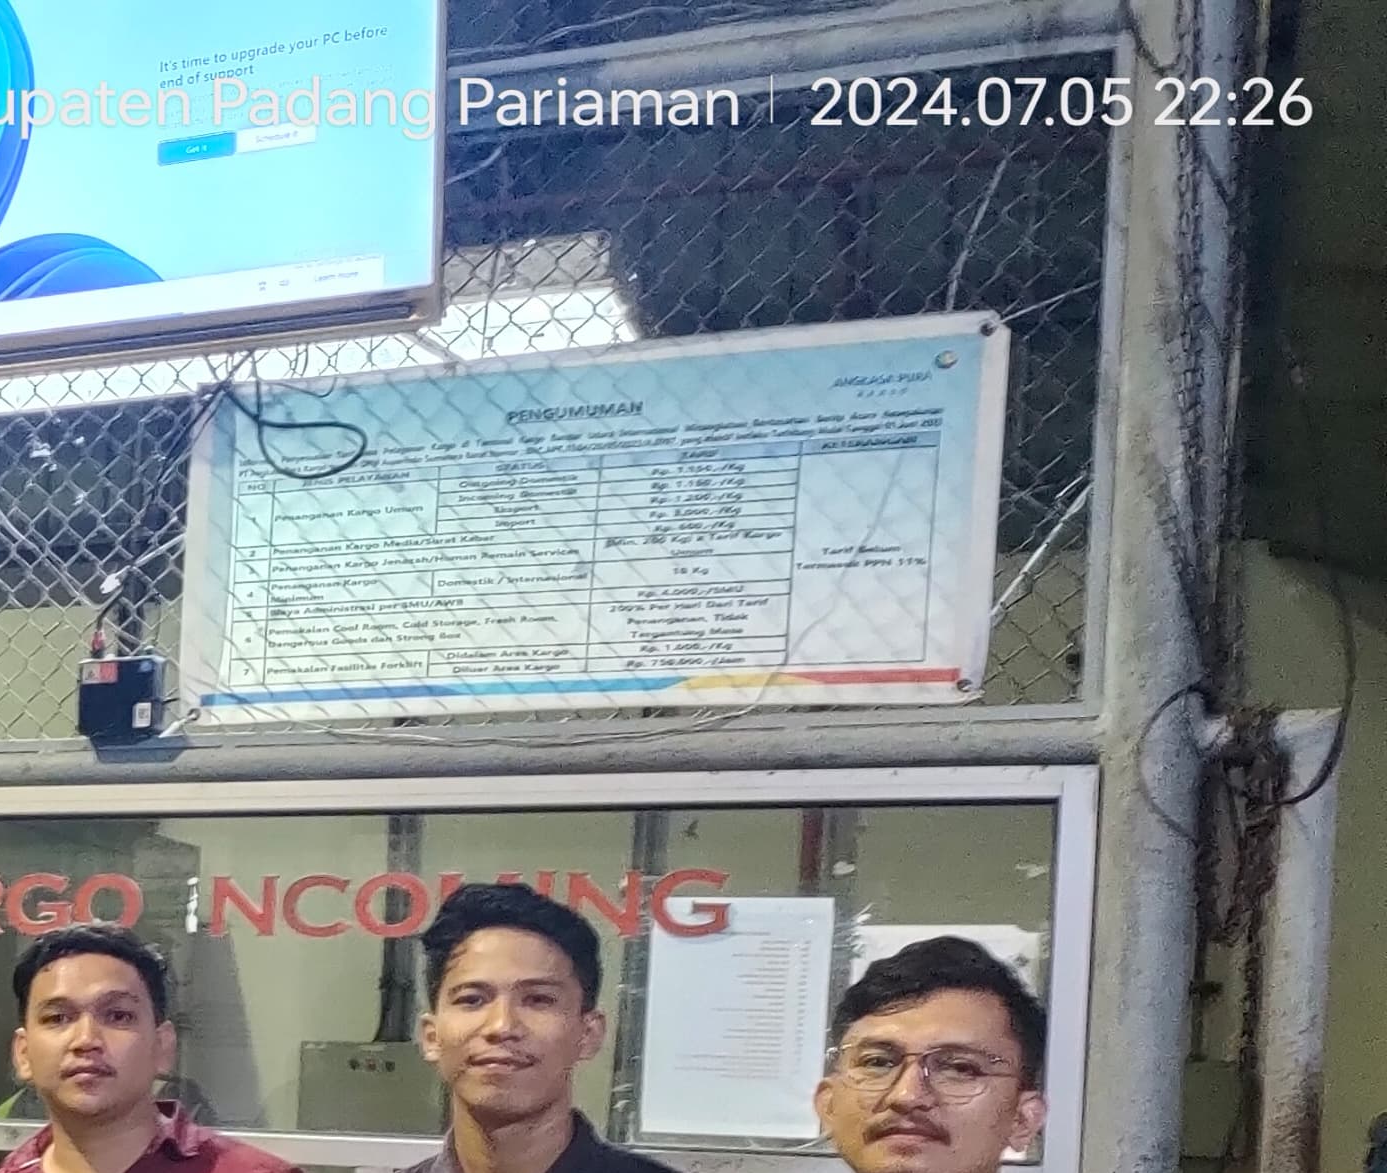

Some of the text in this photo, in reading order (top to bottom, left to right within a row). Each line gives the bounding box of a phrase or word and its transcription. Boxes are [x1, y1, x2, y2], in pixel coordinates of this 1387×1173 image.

[160, 26, 388, 73] It's time to upgrade your PC before
[160, 75, 183, 89] end
[187, 71, 200, 84] of
[507, 401, 643, 423] PENGUMUMAN
[347, 508, 381, 517] Kargo
[273, 545, 341, 556] Penanganan
[345, 541, 380, 551] Kargo
[345, 559, 378, 568] Kargo
